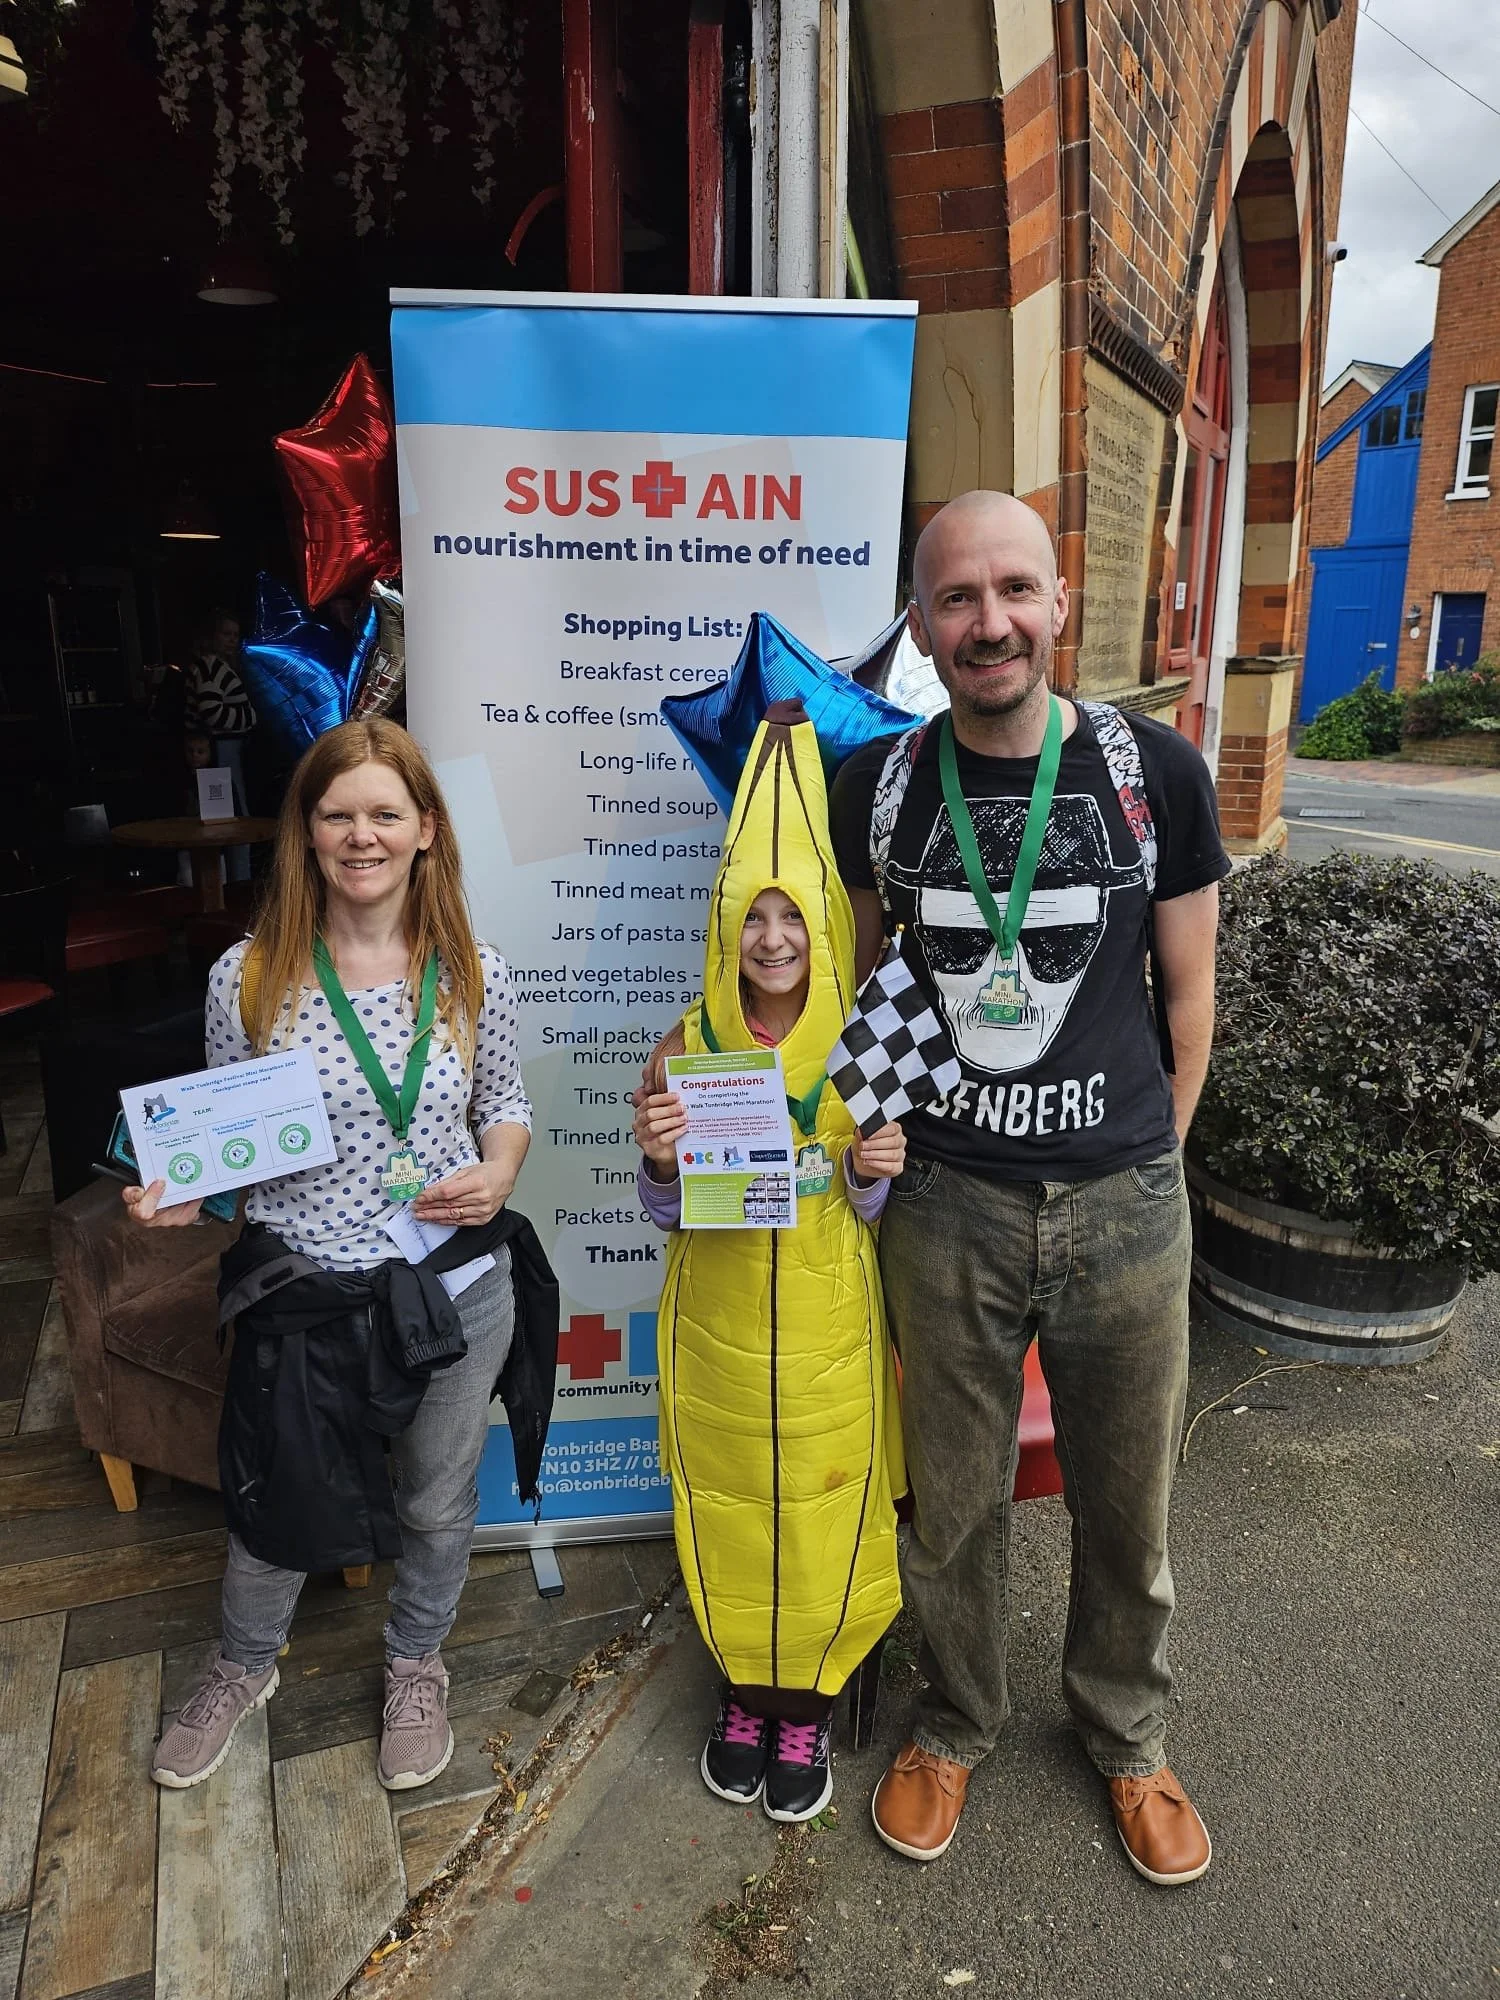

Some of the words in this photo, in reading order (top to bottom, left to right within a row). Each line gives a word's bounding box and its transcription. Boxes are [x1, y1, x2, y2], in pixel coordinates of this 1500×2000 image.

[433, 531, 638, 563] nourishment
[645, 536, 672, 563] in
[679, 537, 752, 565] time
[758, 538, 792, 565] of
[796, 541, 871, 567] need
[564, 612, 683, 641] Shopping
[688, 616, 743, 638] List:
[560, 660, 664, 682] Breakfast
[481, 703, 519, 723] Tea
[524, 704, 540, 724] &
[545, 705, 614, 725] coffee
[580, 750, 677, 775] Long-life
[586, 794, 660, 814] Tinned
[666, 801, 718, 820] soup
[583, 838, 657, 857] Tinned
[662, 841, 721, 862] pasta
[551, 880, 625, 899] Tinned
[630, 883, 685, 900] meat
[551, 923, 595, 941] Jars
[600, 923, 624, 941] of
[627, 925, 685, 945] pasta
[508, 965, 567, 982] inned
[571, 965, 687, 986] vegetables
[516, 987, 621, 1006] weetcorn,
[626, 989, 673, 1007] peas
[981, 995, 1024, 1006] MARATHON
[542, 1026, 598, 1044] Small
[603, 1028, 662, 1047] packs
[573, 1047, 652, 1064] microw
[681, 1077, 765, 1091] Congratulations
[574, 1087, 617, 1105] Tins
[707, 1091, 738, 1099] completing
[192, 1107, 214, 1116] TEAM:
[705, 1101, 732, 1109] Tonbridge
[548, 1127, 621, 1145] Tinned
[383, 1175, 426, 1186] MARATHON
[395, 1170, 412, 1178] MINI
[590, 1167, 640, 1185] Tinn
[555, 1208, 634, 1225] Packets
[585, 1243, 658, 1264] Thank
[557, 1381, 651, 1398] community
[584, 1457, 622, 1473] 3HZ
